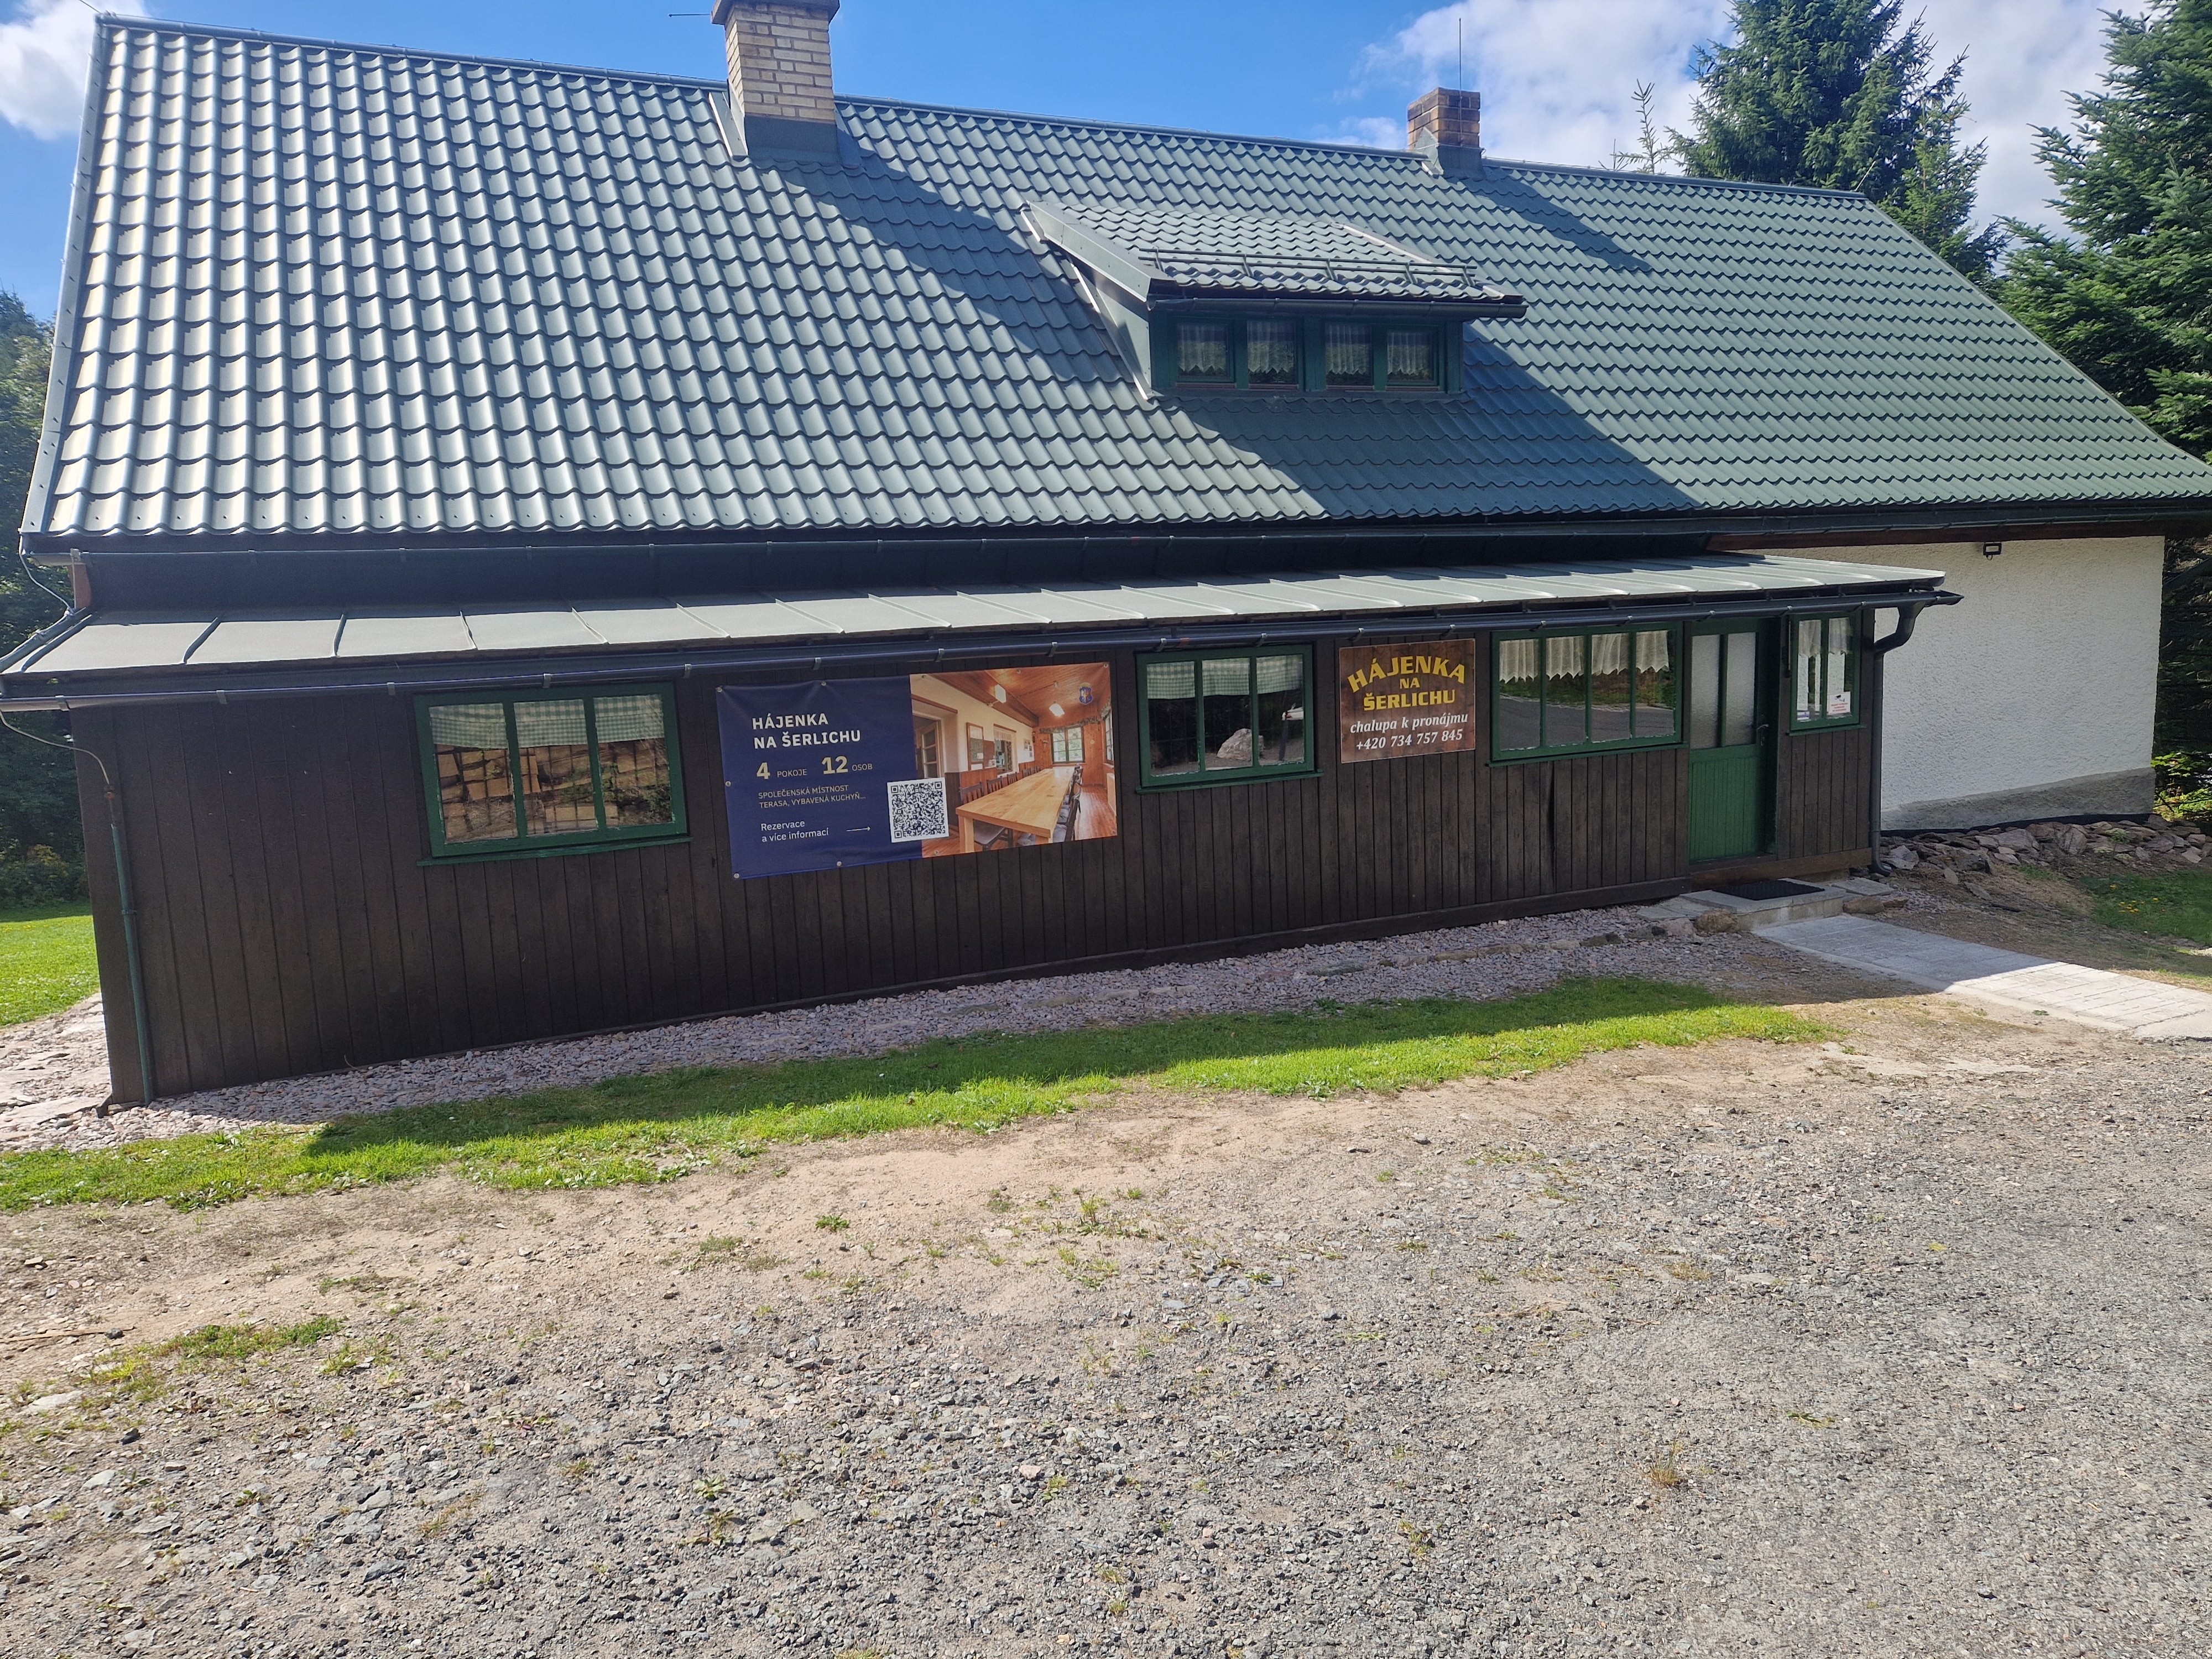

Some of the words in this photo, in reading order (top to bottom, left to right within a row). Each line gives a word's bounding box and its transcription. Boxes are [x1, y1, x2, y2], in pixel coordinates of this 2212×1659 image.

[1348, 655, 1465, 693] HÁJENKA
[1400, 677, 1421, 689] NA
[1363, 690, 1455, 711] ŠERLICHU
[752, 713, 829, 730] HÁJENKA
[1350, 719, 1397, 734] chalupa
[1401, 717, 1408, 729] k
[1412, 712, 1468, 731] pronájmu
[754, 736, 777, 749] NA
[782, 730, 860, 747] ŠERLICHU
[1357, 737, 1386, 750] +420
[1391, 734, 1412, 747] 734
[1416, 732, 1438, 745] 757
[1441, 729, 1463, 742] 845
[757, 762, 770, 780] 4
[777, 769, 807, 778] POKOJE
[821, 756, 848, 774] 12
[852, 763, 873, 771] OSOB
[758, 787, 810, 799] SPOLEČENSKÁ
[812, 785, 849, 794] MÍSTNOST
[759, 800, 790, 808] TERASA,
[791, 794, 830, 806] VYBAVENÁ
[831, 792, 866, 802] KUCHYŇ...
[761, 821, 805, 831] Rezervace
[769, 833, 786, 841] více
[789, 827, 829, 839] informací
